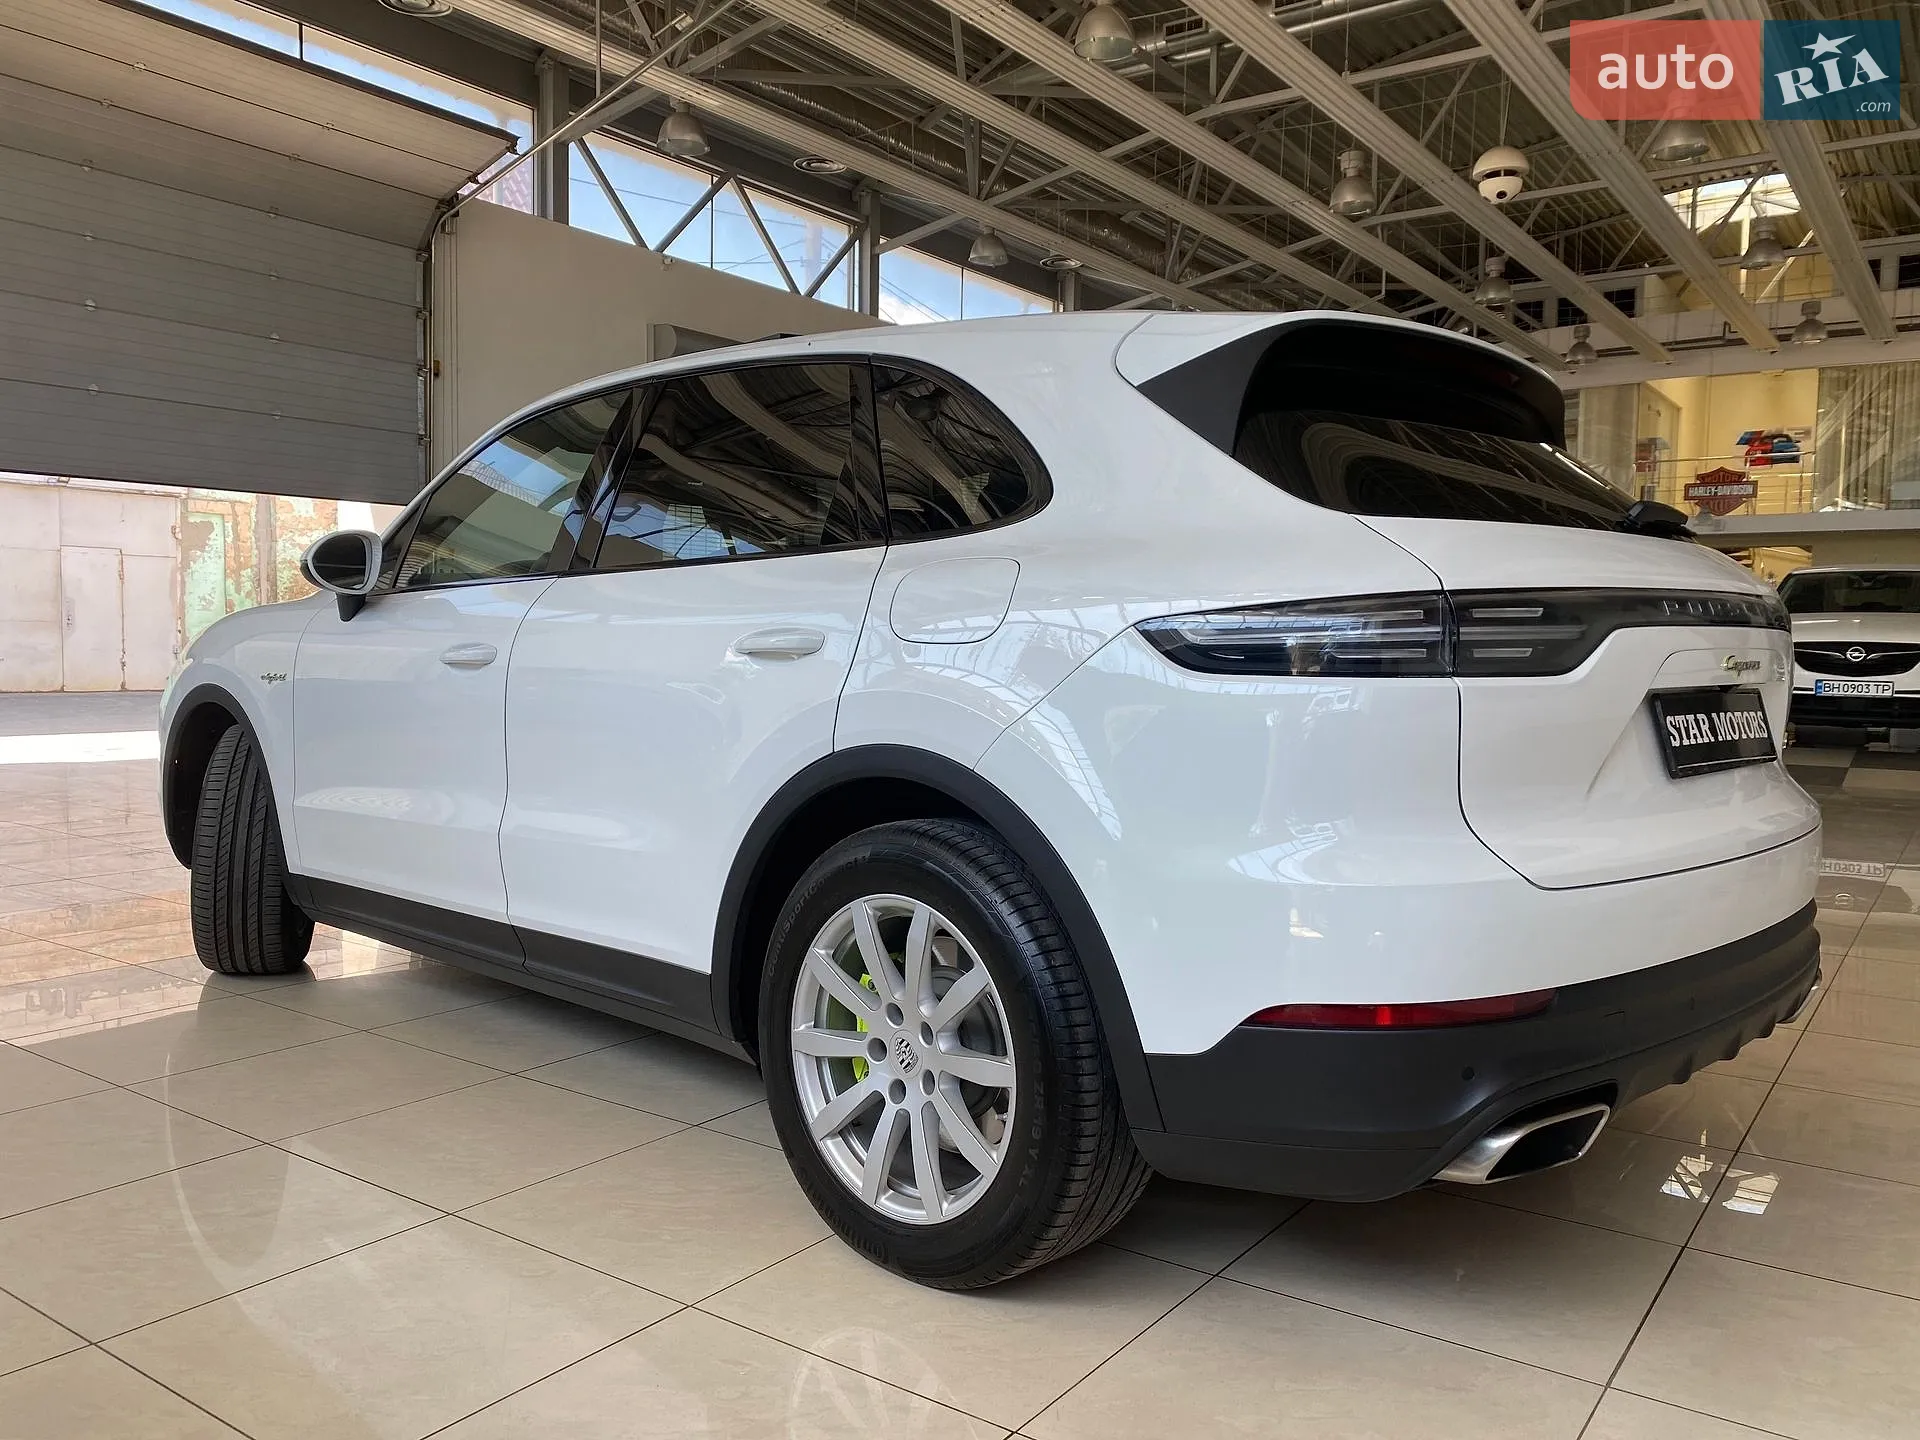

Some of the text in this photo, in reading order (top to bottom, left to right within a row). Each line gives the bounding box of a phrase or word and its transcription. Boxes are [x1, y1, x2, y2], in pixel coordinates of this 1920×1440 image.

[1688, 485, 1754, 497] HARLEY-DAVIDSON
[1823, 682, 1841, 693] BH
[1842, 683, 1871, 693] 0903
[1873, 684, 1891, 694] TP
[1666, 710, 1768, 747] STAR MOTORS
